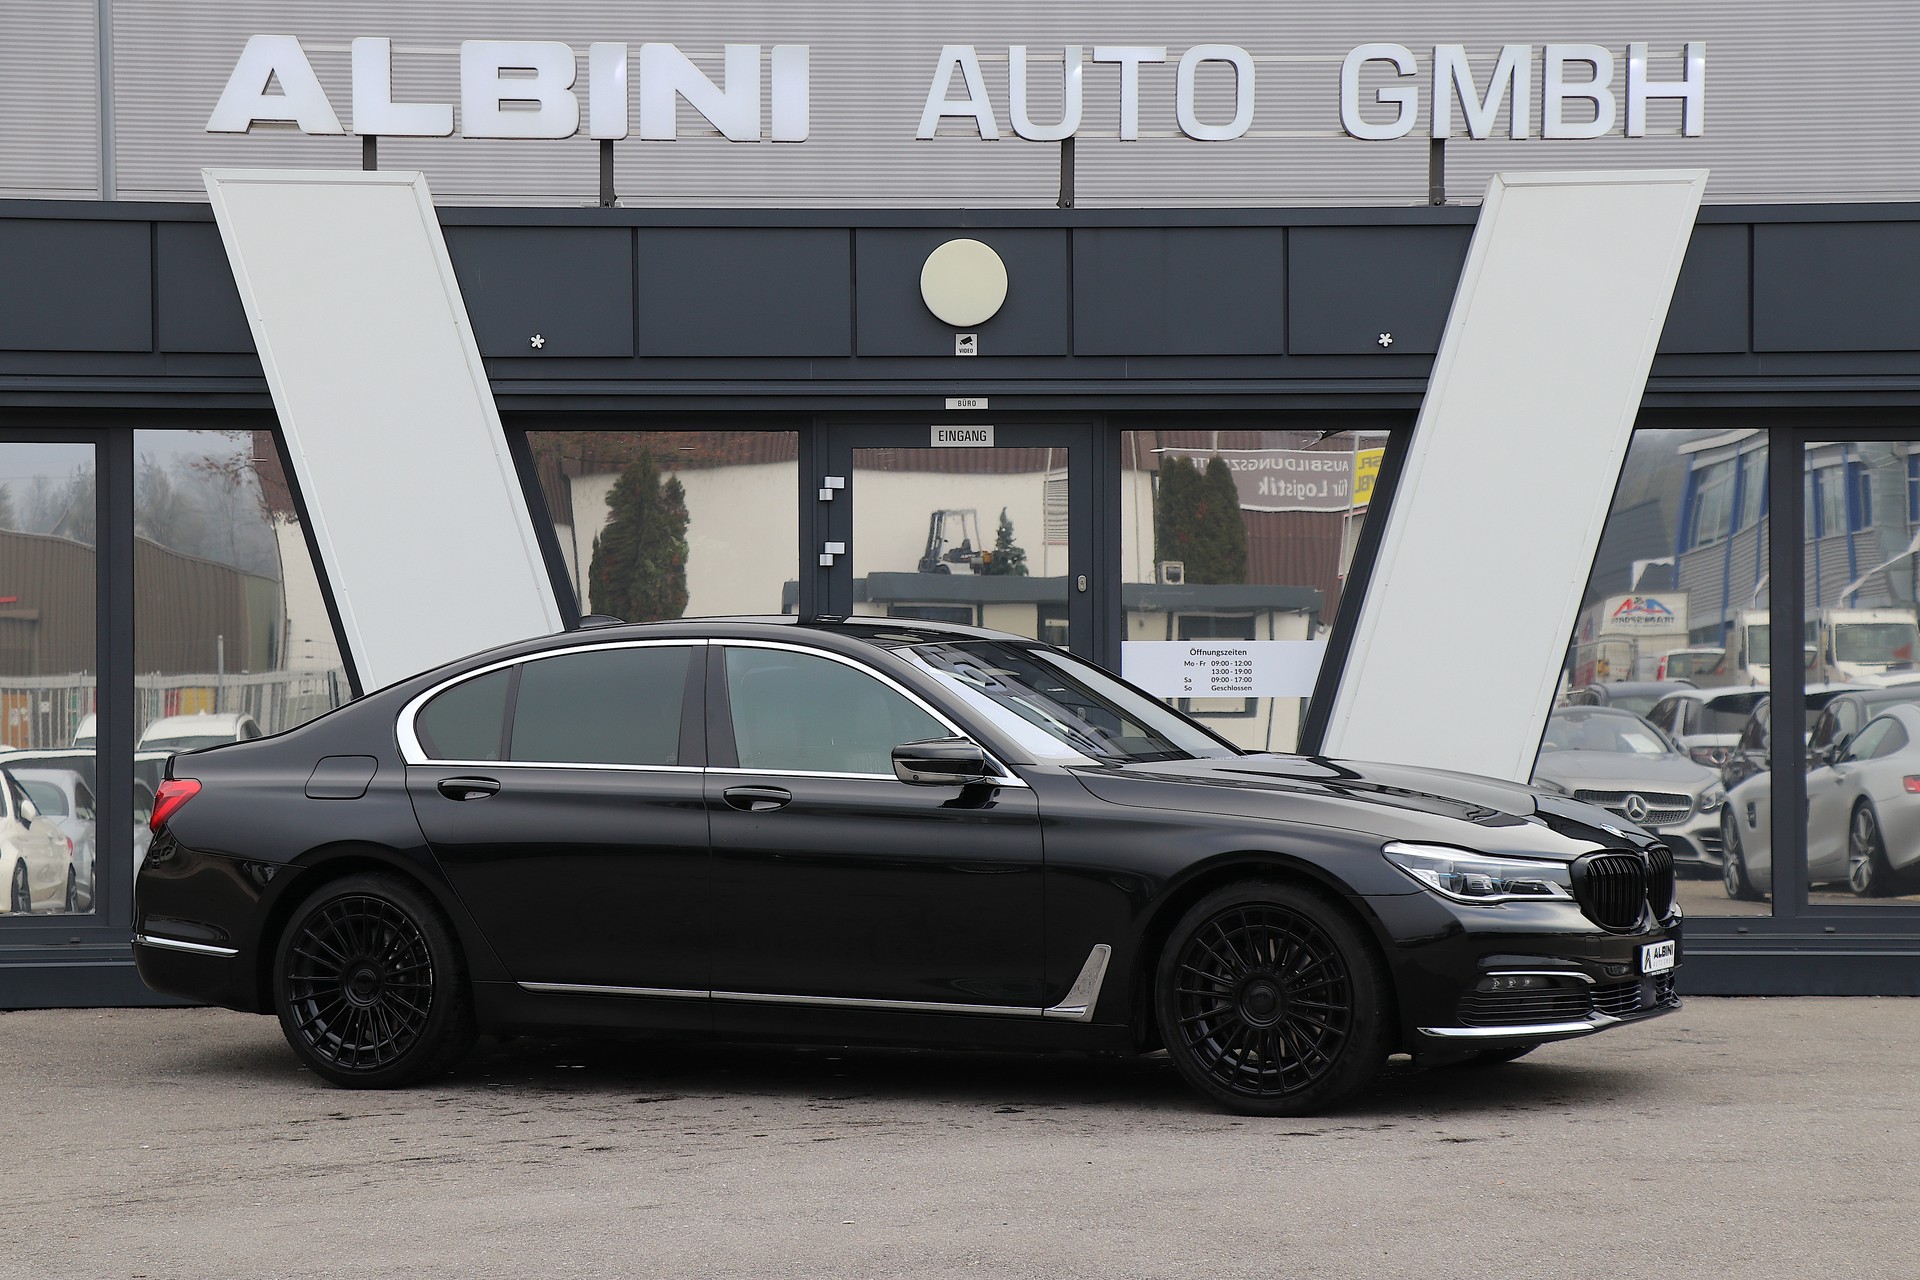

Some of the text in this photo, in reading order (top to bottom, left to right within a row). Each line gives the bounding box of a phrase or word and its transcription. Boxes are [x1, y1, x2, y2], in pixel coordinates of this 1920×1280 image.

[205, 34, 1706, 143] ALBINI AUTO GMBH
[957, 399, 977, 407] BÜRO
[938, 430, 987, 442] EINGANG
[1189, 648, 1248, 657] Öffnungszeiten
[1653, 944, 1674, 959] ALBINI
